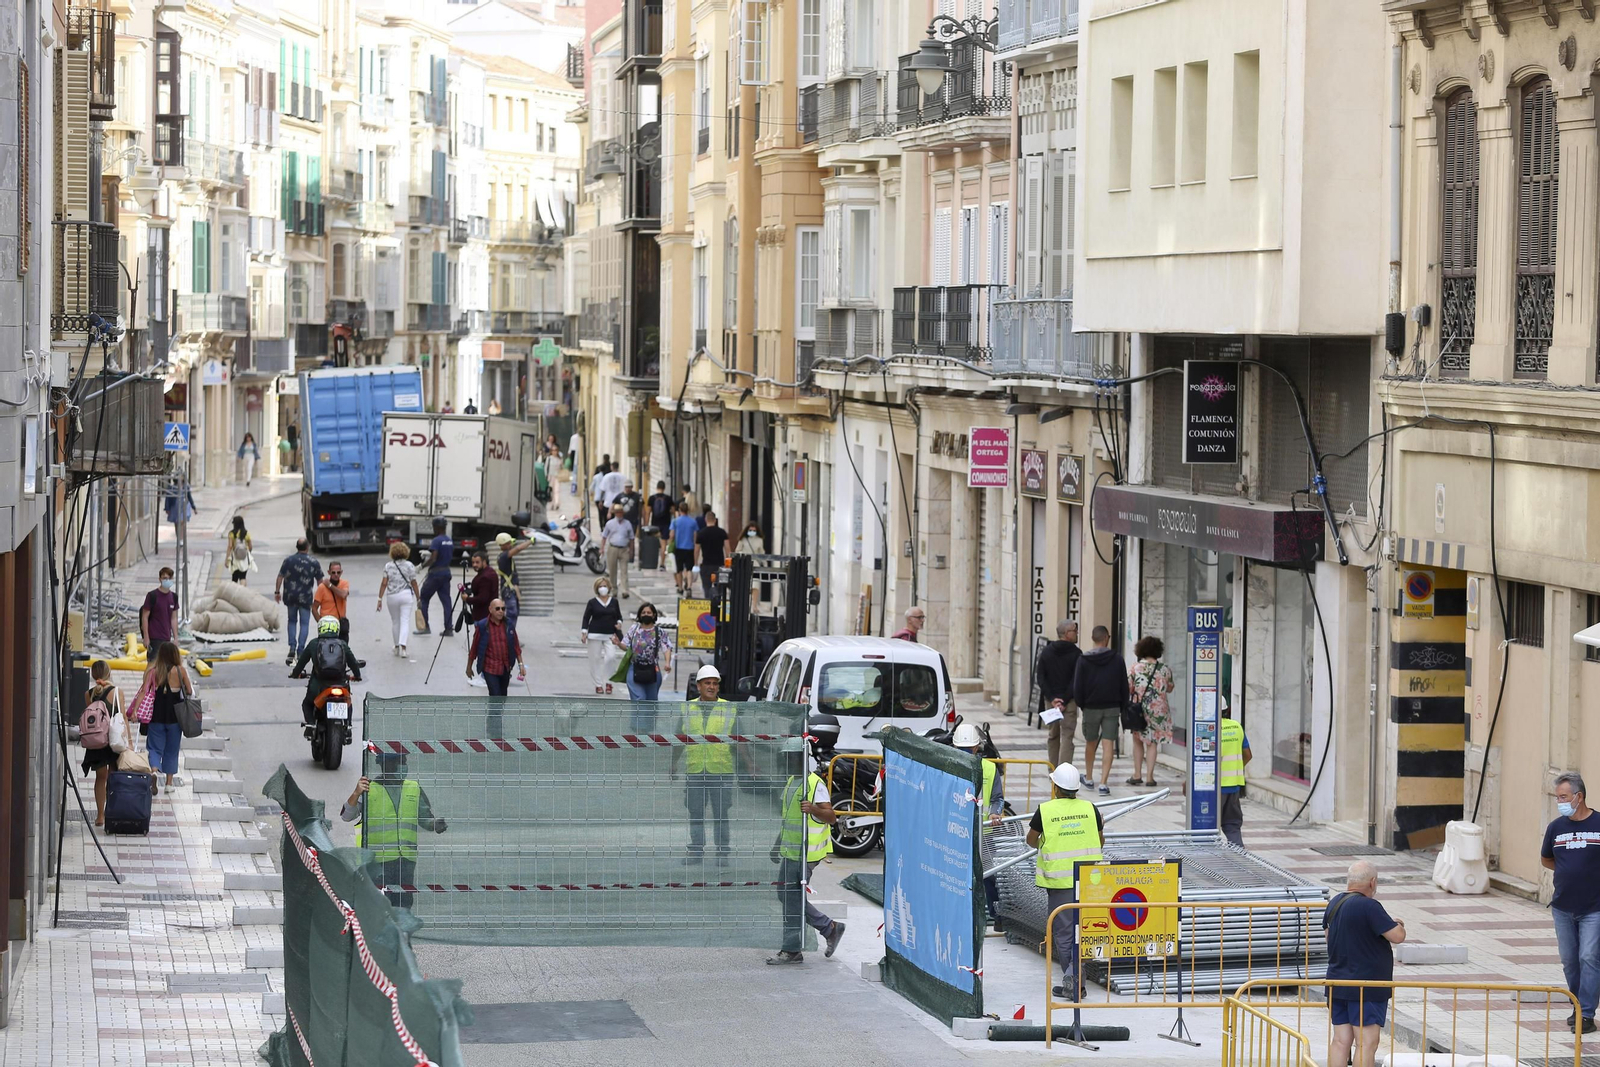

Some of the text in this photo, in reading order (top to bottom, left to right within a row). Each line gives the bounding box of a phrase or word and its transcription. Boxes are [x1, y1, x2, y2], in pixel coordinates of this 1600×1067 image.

[1190, 415, 1234, 423] FLAMENCA
[1188, 428, 1235, 438] COMUNIÓN
[389, 432, 447, 448] RDA
[488, 439, 511, 461] RDA
[1197, 444, 1226, 453] DANZA
[971, 472, 1007, 484] COMUNIONES
[1129, 512, 1149, 524] FLAMENCA
[1206, 525, 1240, 539] DANZA CLÁSICA
[1034, 566, 1044, 634] TATTOO
[1069, 574, 1080, 644] TATT
[1195, 612, 1218, 628] BUS
[1199, 648, 1214, 660] 36
[1138, 865, 1166, 875] LOCAL
[1115, 876, 1154, 885] MALAGA
[1080, 935, 1115, 945] PROHIBIDO
[1116, 932, 1154, 945] ESTACIONAR
[1080, 947, 1092, 957] LAS
[1096, 946, 1102, 957] 7
[1122, 946, 1135, 956] DEL
[1166, 942, 1172, 953] 8
